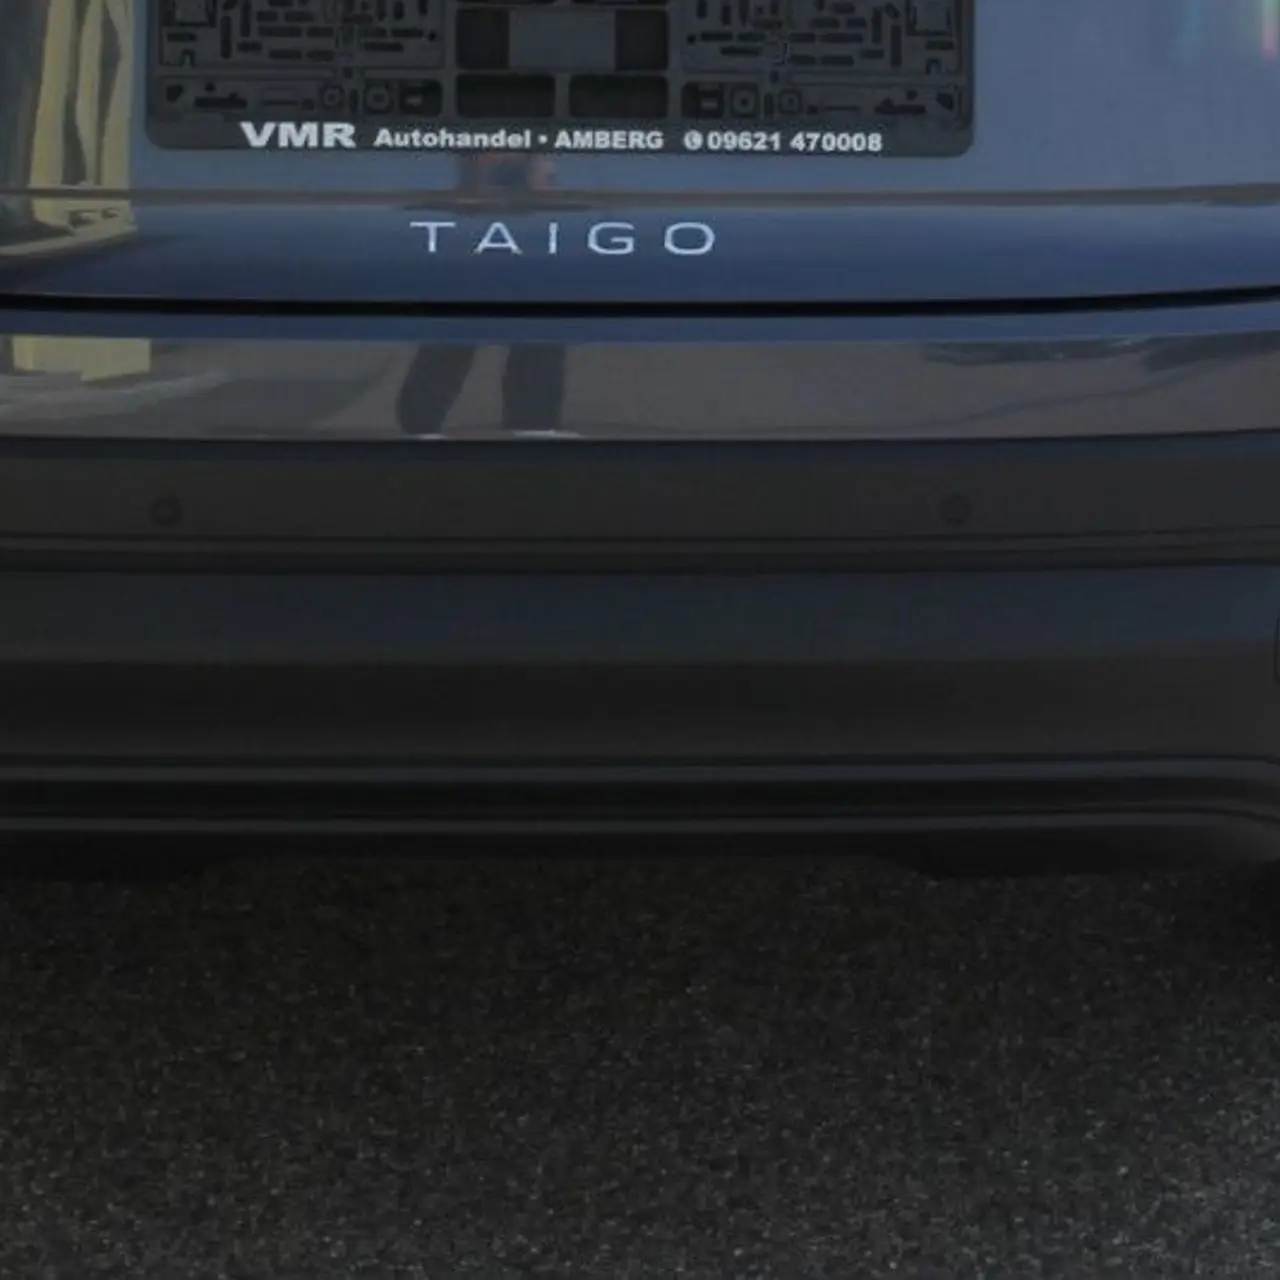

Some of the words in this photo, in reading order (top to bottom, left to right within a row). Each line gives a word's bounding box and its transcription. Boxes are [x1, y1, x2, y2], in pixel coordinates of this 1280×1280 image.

[240, 121, 357, 148] VMR
[373, 127, 531, 149] Autohandel
[554, 129, 664, 150] AMBERG
[707, 131, 781, 151] 09621
[789, 131, 883, 152] 470008
[409, 221, 717, 256] TAIGO
